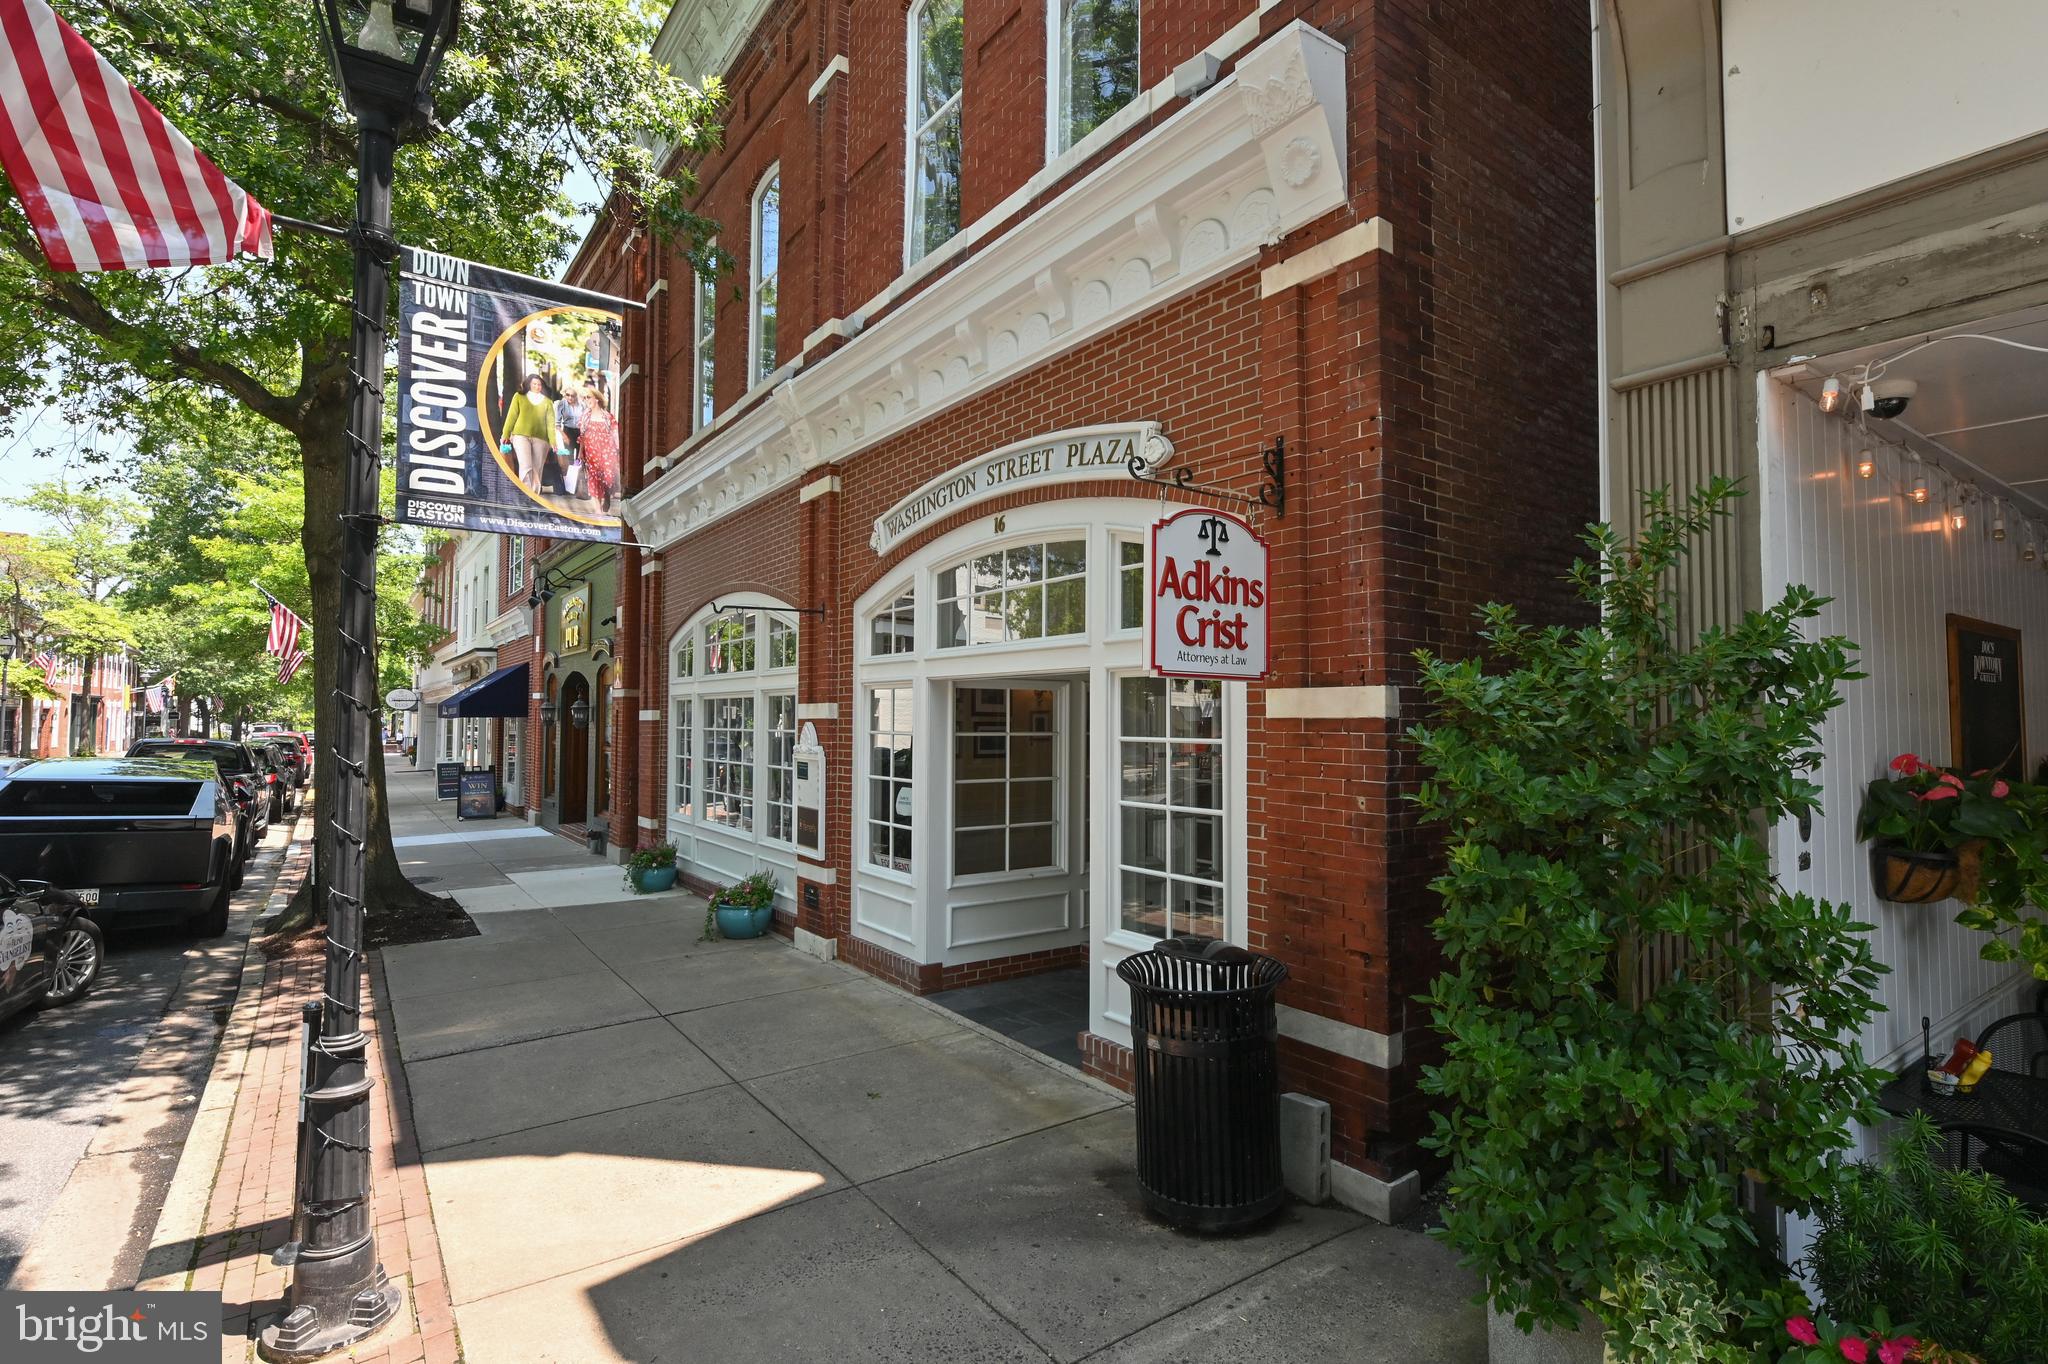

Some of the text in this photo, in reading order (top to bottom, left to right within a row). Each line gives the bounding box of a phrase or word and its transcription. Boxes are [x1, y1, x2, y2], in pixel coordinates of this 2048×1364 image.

[412, 247, 470, 286] DOWN
[411, 280, 468, 316] TOWN
[409, 311, 468, 495] DISCOVER
[887, 438, 1135, 539] WASHINGTON STREET PLAZA
[407, 500, 465, 514] DISCOVER
[407, 507, 465, 524] EASTON
[479, 516, 601, 536] www.DiscoverEaston.com
[994, 515, 1006, 534] 16
[1157, 556, 1265, 609] Adkins
[565, 625, 579, 649] PUB
[1176, 604, 1249, 651] Crist
[1177, 650, 1248, 667] Attorneys at Law
